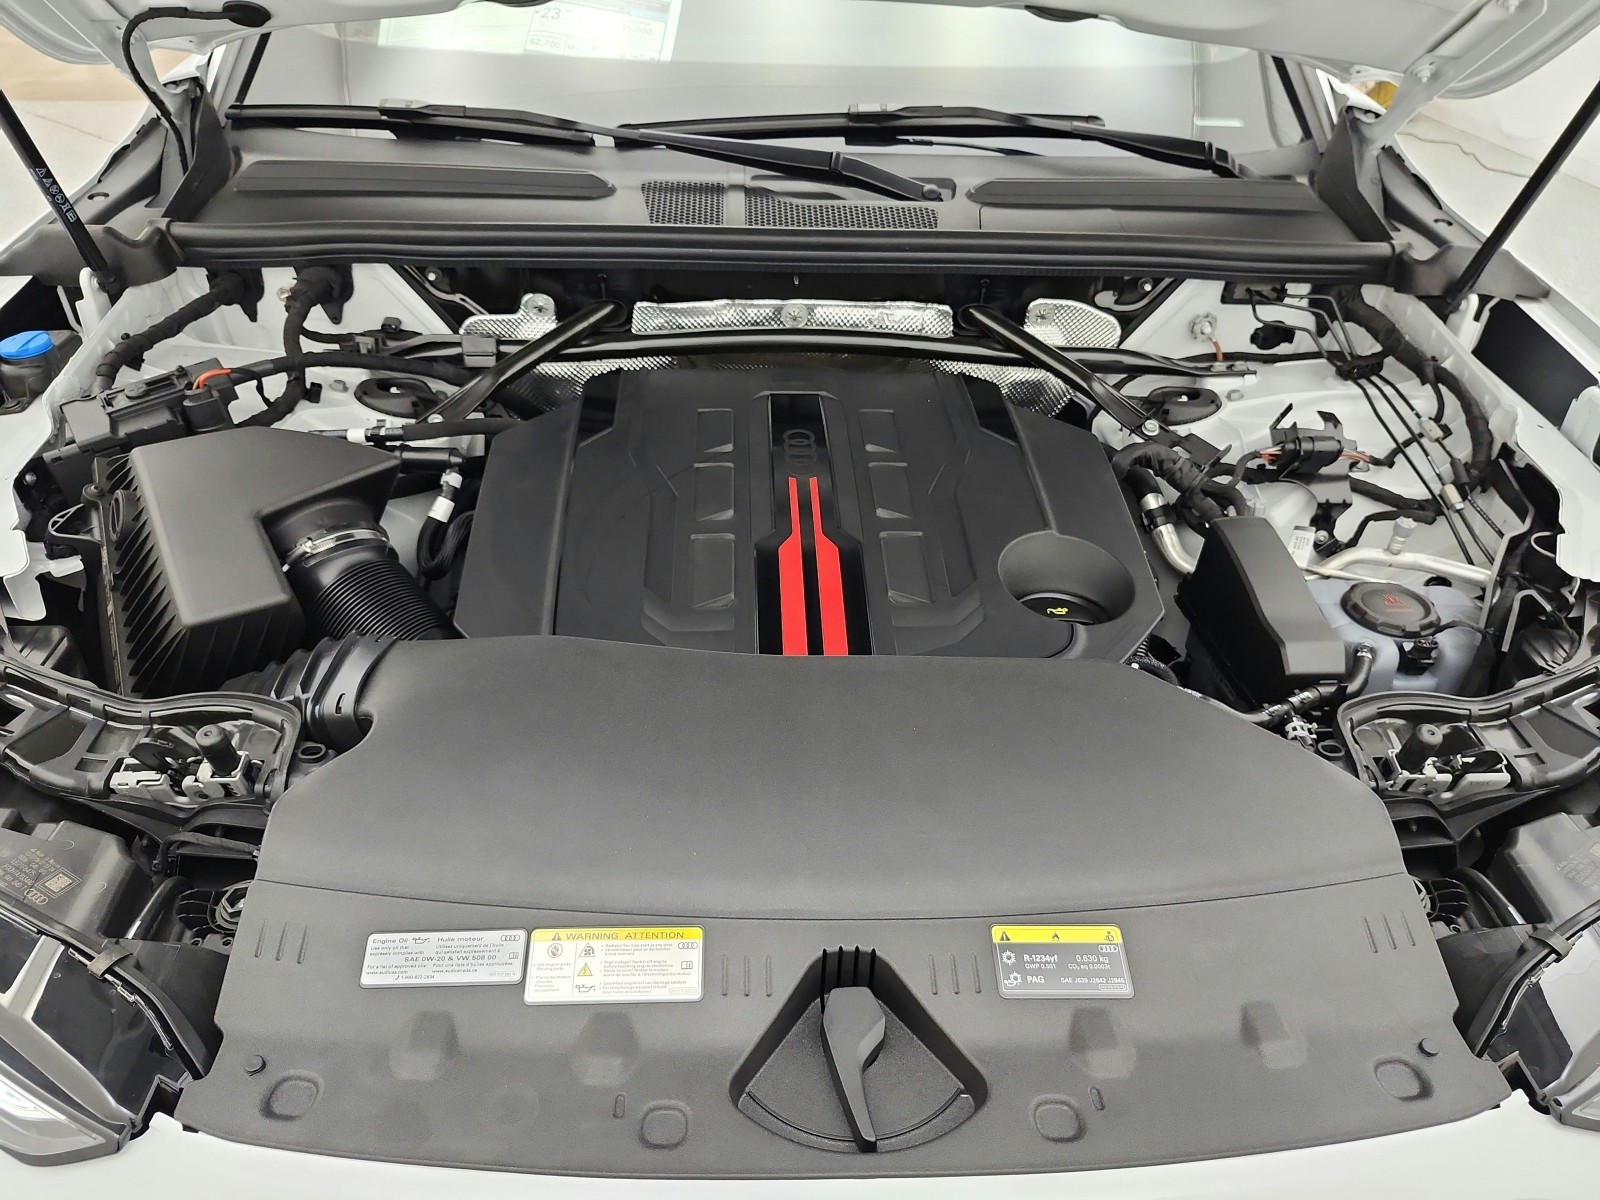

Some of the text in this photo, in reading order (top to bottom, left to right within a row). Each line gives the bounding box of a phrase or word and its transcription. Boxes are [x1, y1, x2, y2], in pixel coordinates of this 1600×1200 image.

[540, 6, 562, 20] 23
[566, 931, 684, 940] WARNING ATTENTION
[1023, 954, 1109, 964] R-1234yf 0.630 kg
[1027, 975, 1045, 983] PAG
